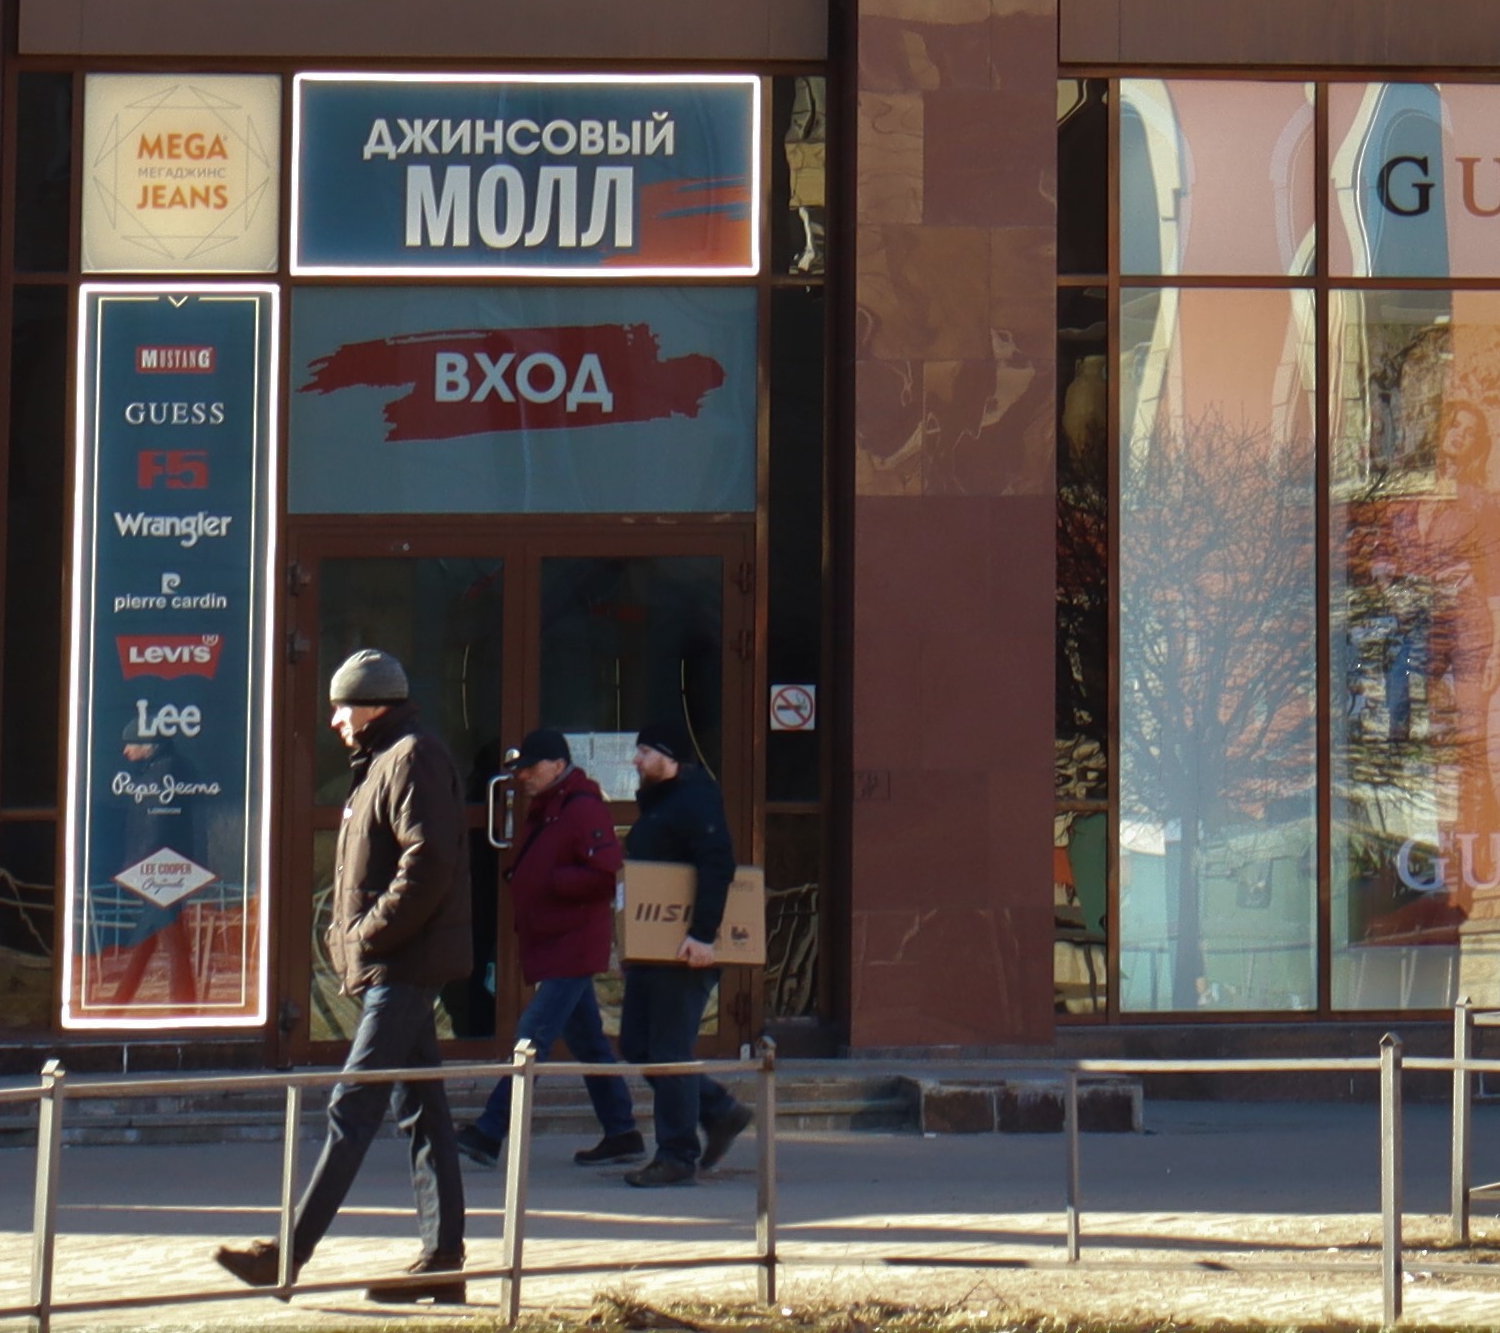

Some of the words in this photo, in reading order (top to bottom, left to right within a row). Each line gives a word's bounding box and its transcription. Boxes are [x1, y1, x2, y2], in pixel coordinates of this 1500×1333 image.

[137, 133, 228, 161] MEGA
[362, 111, 675, 161] ДЖИНСОВЫЙ
[137, 166, 226, 180] МЕГАДЖИНС
[136, 184, 229, 210] JEANS
[405, 163, 634, 249] МОЛЛ
[141, 349, 211, 369] MUSTANG
[435, 352, 614, 413] ВХОД
[124, 401, 225, 425] GUESS
[137, 449, 209, 489] F5
[113, 511, 233, 548] Wrangler
[113, 593, 166, 614] pierre
[171, 592, 228, 609] cardin
[135, 699, 201, 738] Lee
[112, 771, 161, 804] Pepe
[158, 774, 222, 804] Jeans
[140, 863, 156, 875] LEE
[158, 862, 192, 875] COOPER
